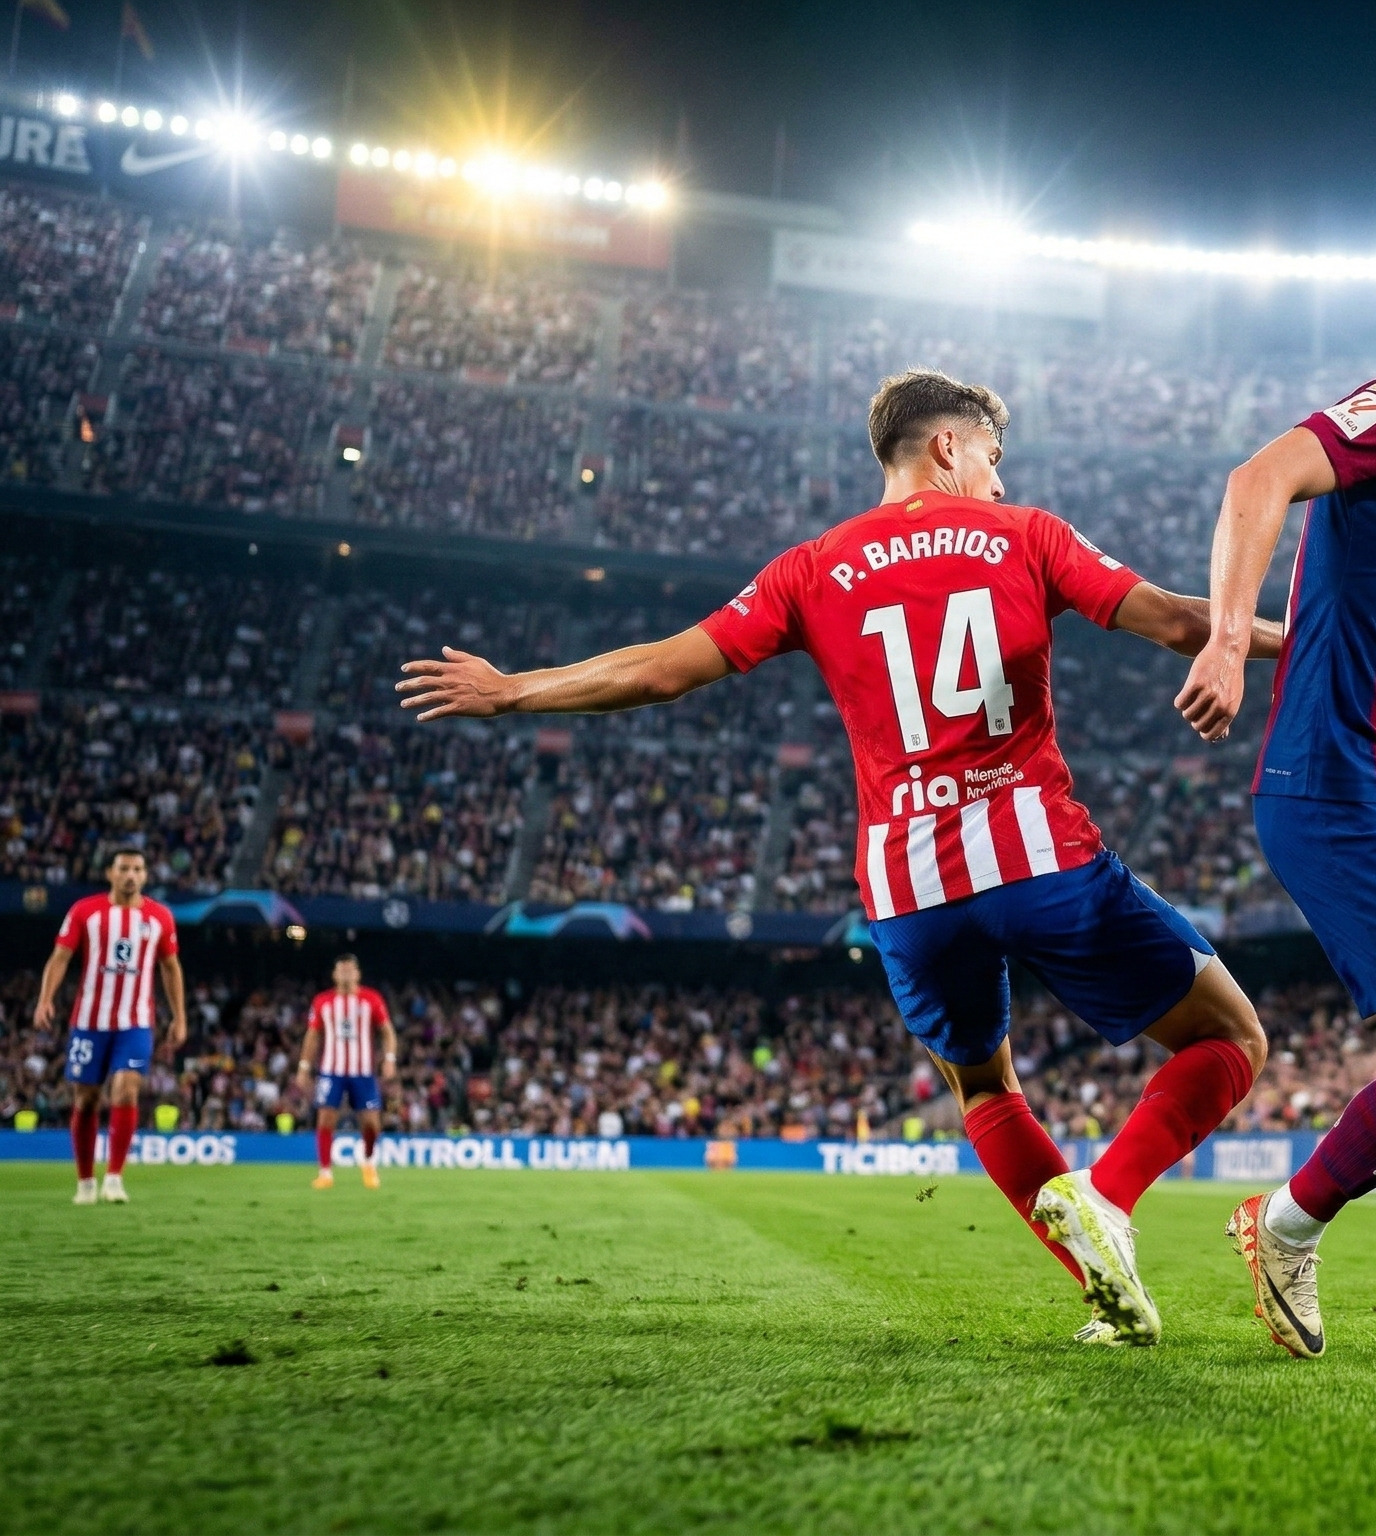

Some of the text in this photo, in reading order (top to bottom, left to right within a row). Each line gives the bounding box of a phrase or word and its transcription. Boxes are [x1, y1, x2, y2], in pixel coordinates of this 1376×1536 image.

[829, 527, 1010, 592] P. BARRIOS
[860, 587, 1015, 754] 14
[892, 764, 960, 817] ria
